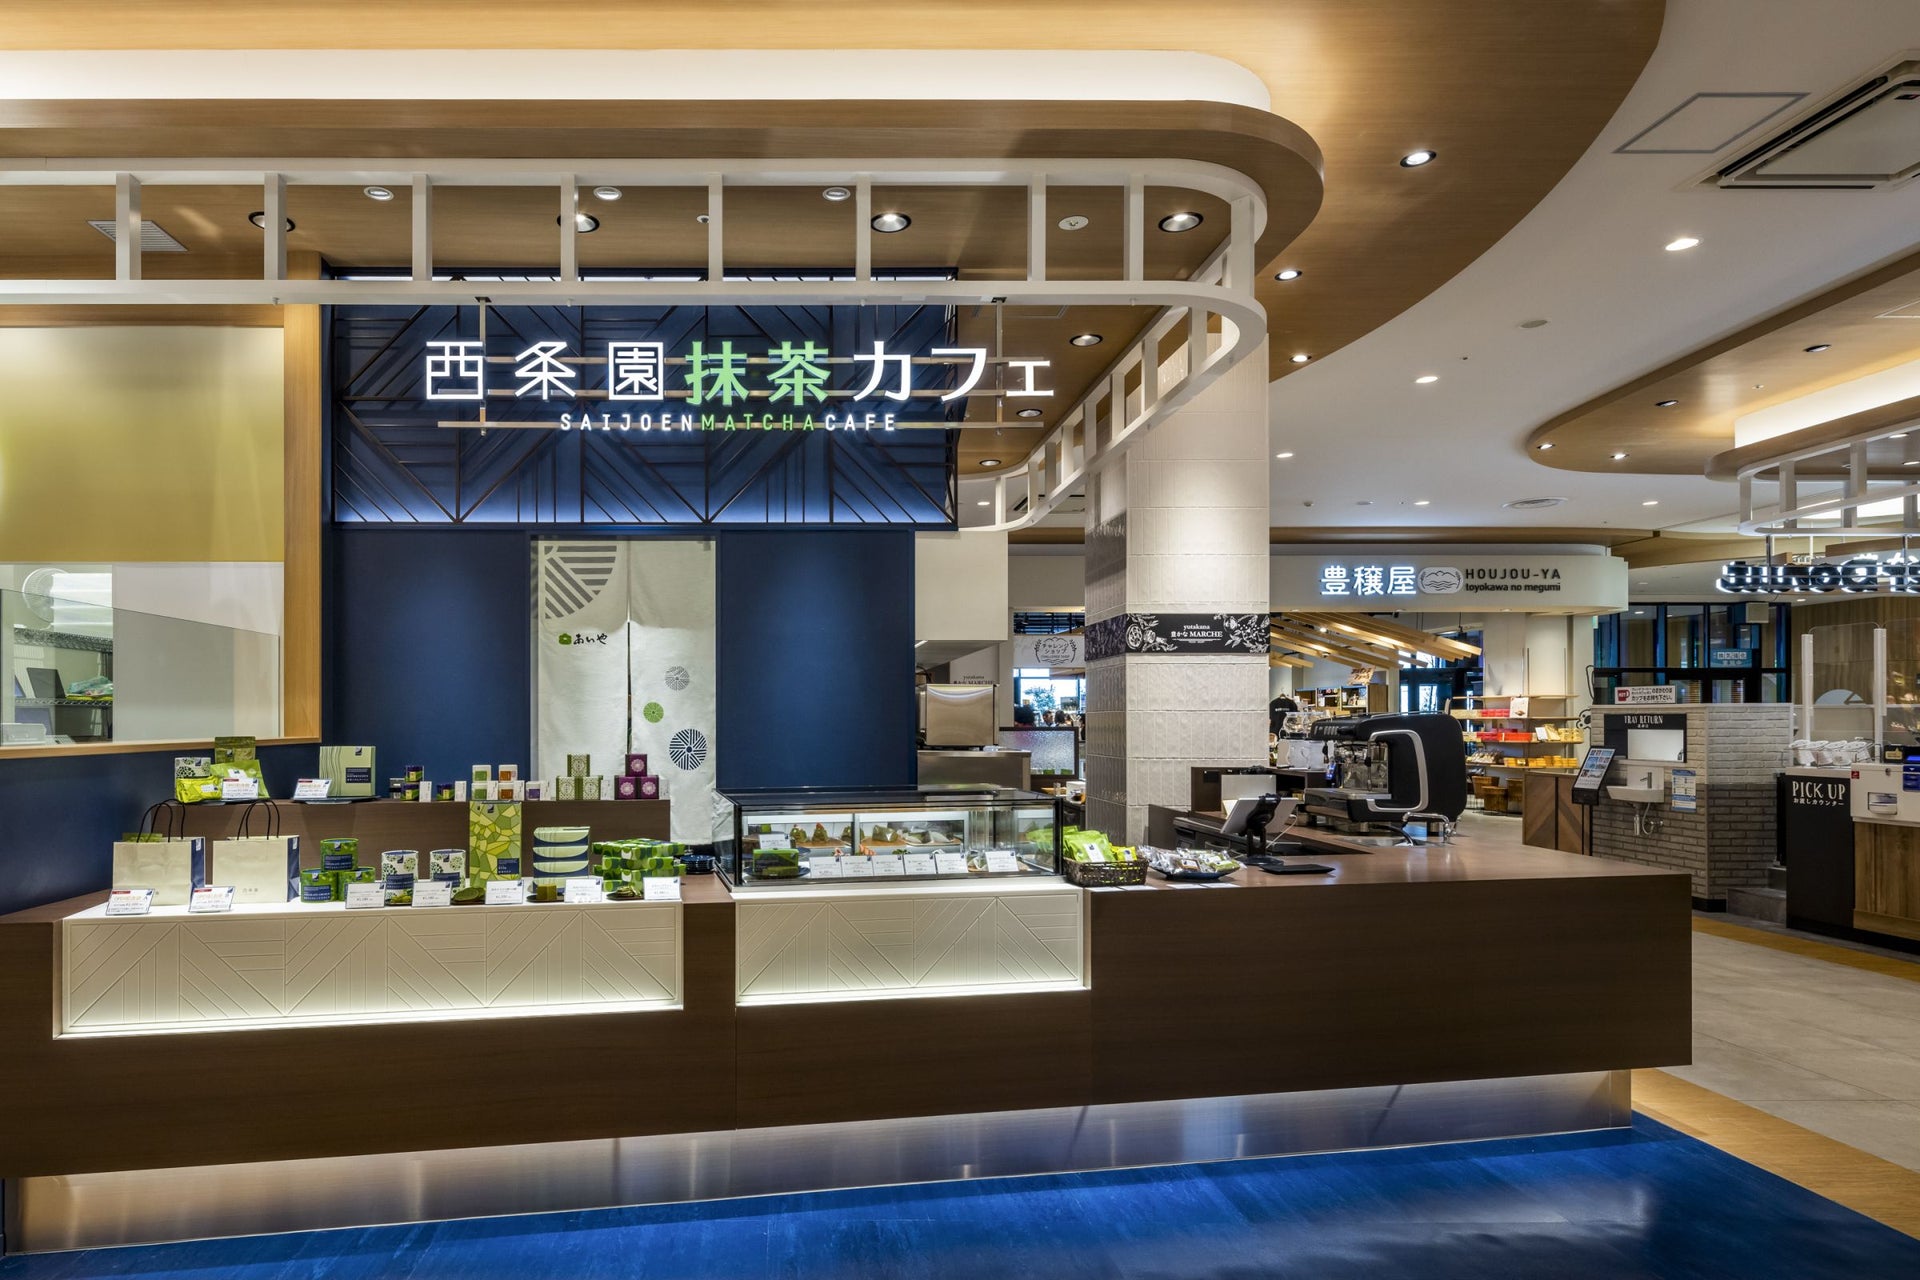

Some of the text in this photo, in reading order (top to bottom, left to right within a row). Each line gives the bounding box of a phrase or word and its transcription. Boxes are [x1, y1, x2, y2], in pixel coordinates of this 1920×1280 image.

[425, 339, 1054, 406] 西条園抹茶カフェ
[1320, 565, 1417, 596] 豊穣屋
[1465, 567, 1561, 580] HOUJOU-YA
[1465, 582, 1561, 594] toyokawa no megumi
[1624, 715, 1663, 724] TRAY RETURN
[1792, 781, 1845, 799] PICK UP
